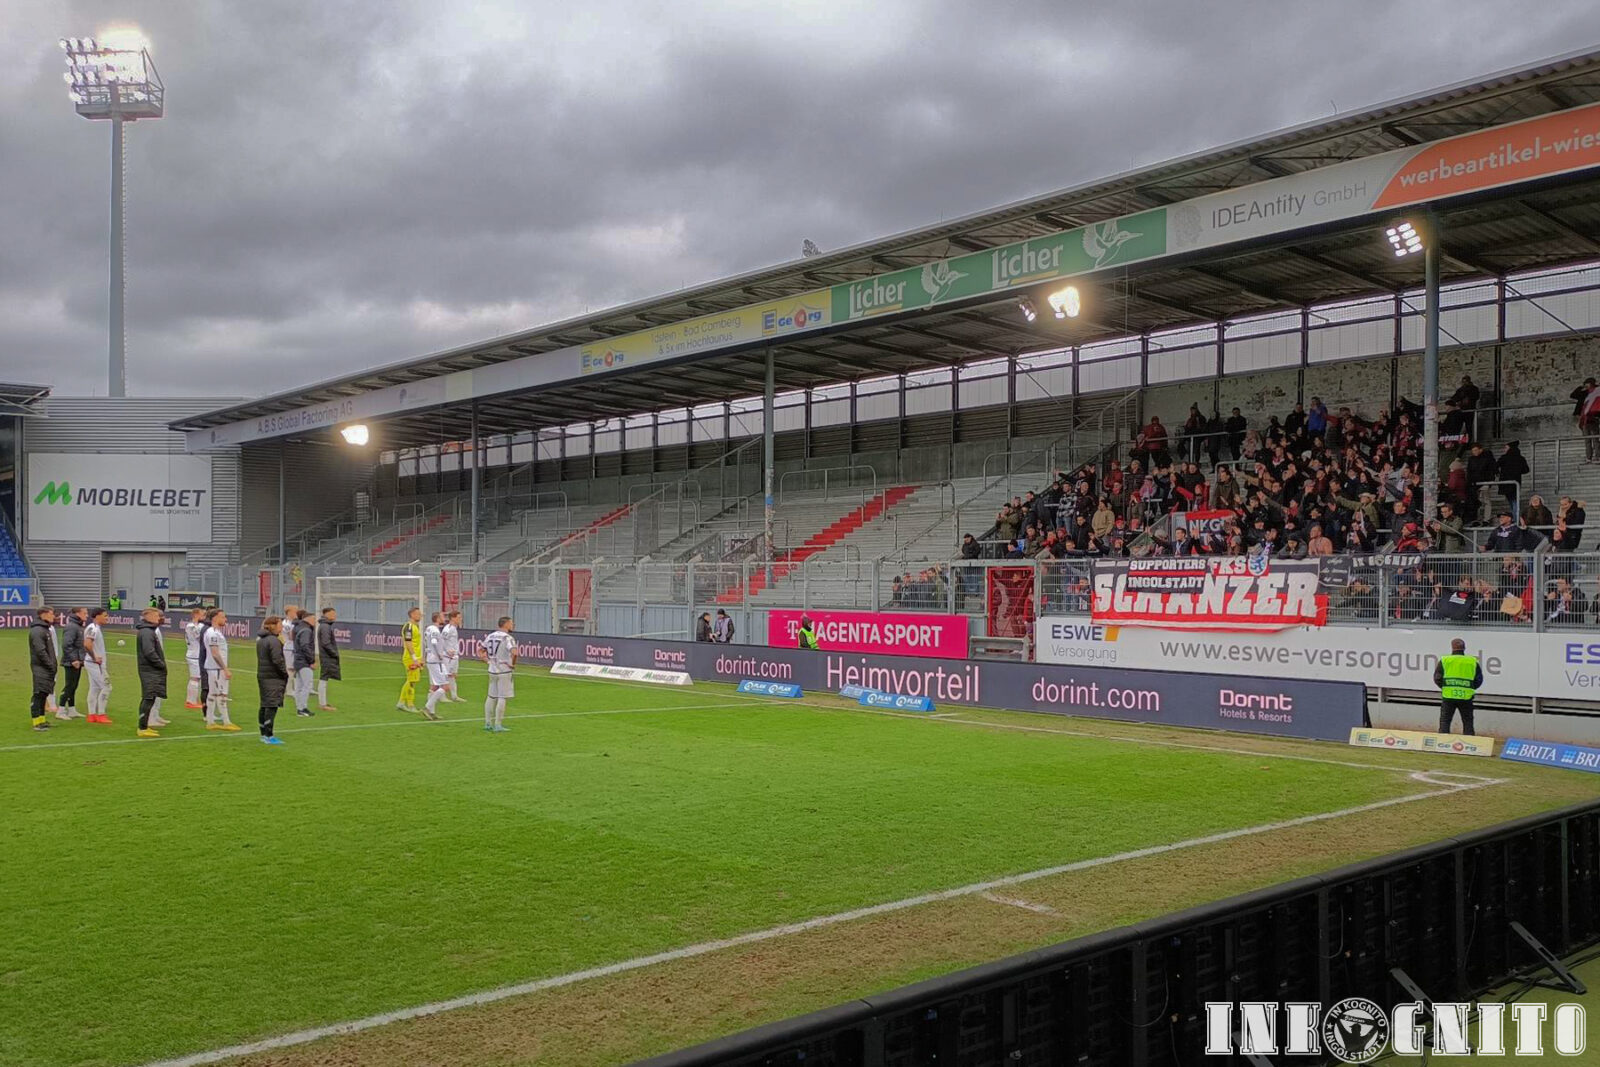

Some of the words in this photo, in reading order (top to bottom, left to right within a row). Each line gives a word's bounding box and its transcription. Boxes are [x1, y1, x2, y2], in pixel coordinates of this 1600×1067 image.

[1211, 192, 1307, 230] IDEAntity
[1313, 180, 1367, 207] GmbH
[992, 242, 1064, 290] Licher
[848, 278, 906, 319] Licher
[302, 406, 339, 425] Factoring
[340, 400, 353, 418] AG
[77, 487, 206, 507] MOBILEBET
[1129, 558, 1205, 571] SUPPORTERS
[1128, 575, 1204, 589] INGOLSTADT
[884, 624, 943, 648] SPORT
[1051, 624, 1103, 641] ESWE
[487, 639, 501, 656] 37
[586, 644, 614, 657] Dorint
[654, 649, 686, 662] Dorint
[1051, 644, 1118, 663] Versorgung
[716, 654, 792, 679] dorint.com
[1160, 641, 1502, 677] www.eswe-versorgune
[827, 655, 980, 702] Heimvorteil
[1565, 669, 1600, 688] Ver
[1032, 677, 1160, 711] dorint.com
[1219, 689, 1292, 711] Dorint
[1219, 708, 1247, 719] Hotels
[1250, 711, 1256, 720] &
[1258, 711, 1292, 723] Resorts
[1519, 743, 1557, 761] BRITA
